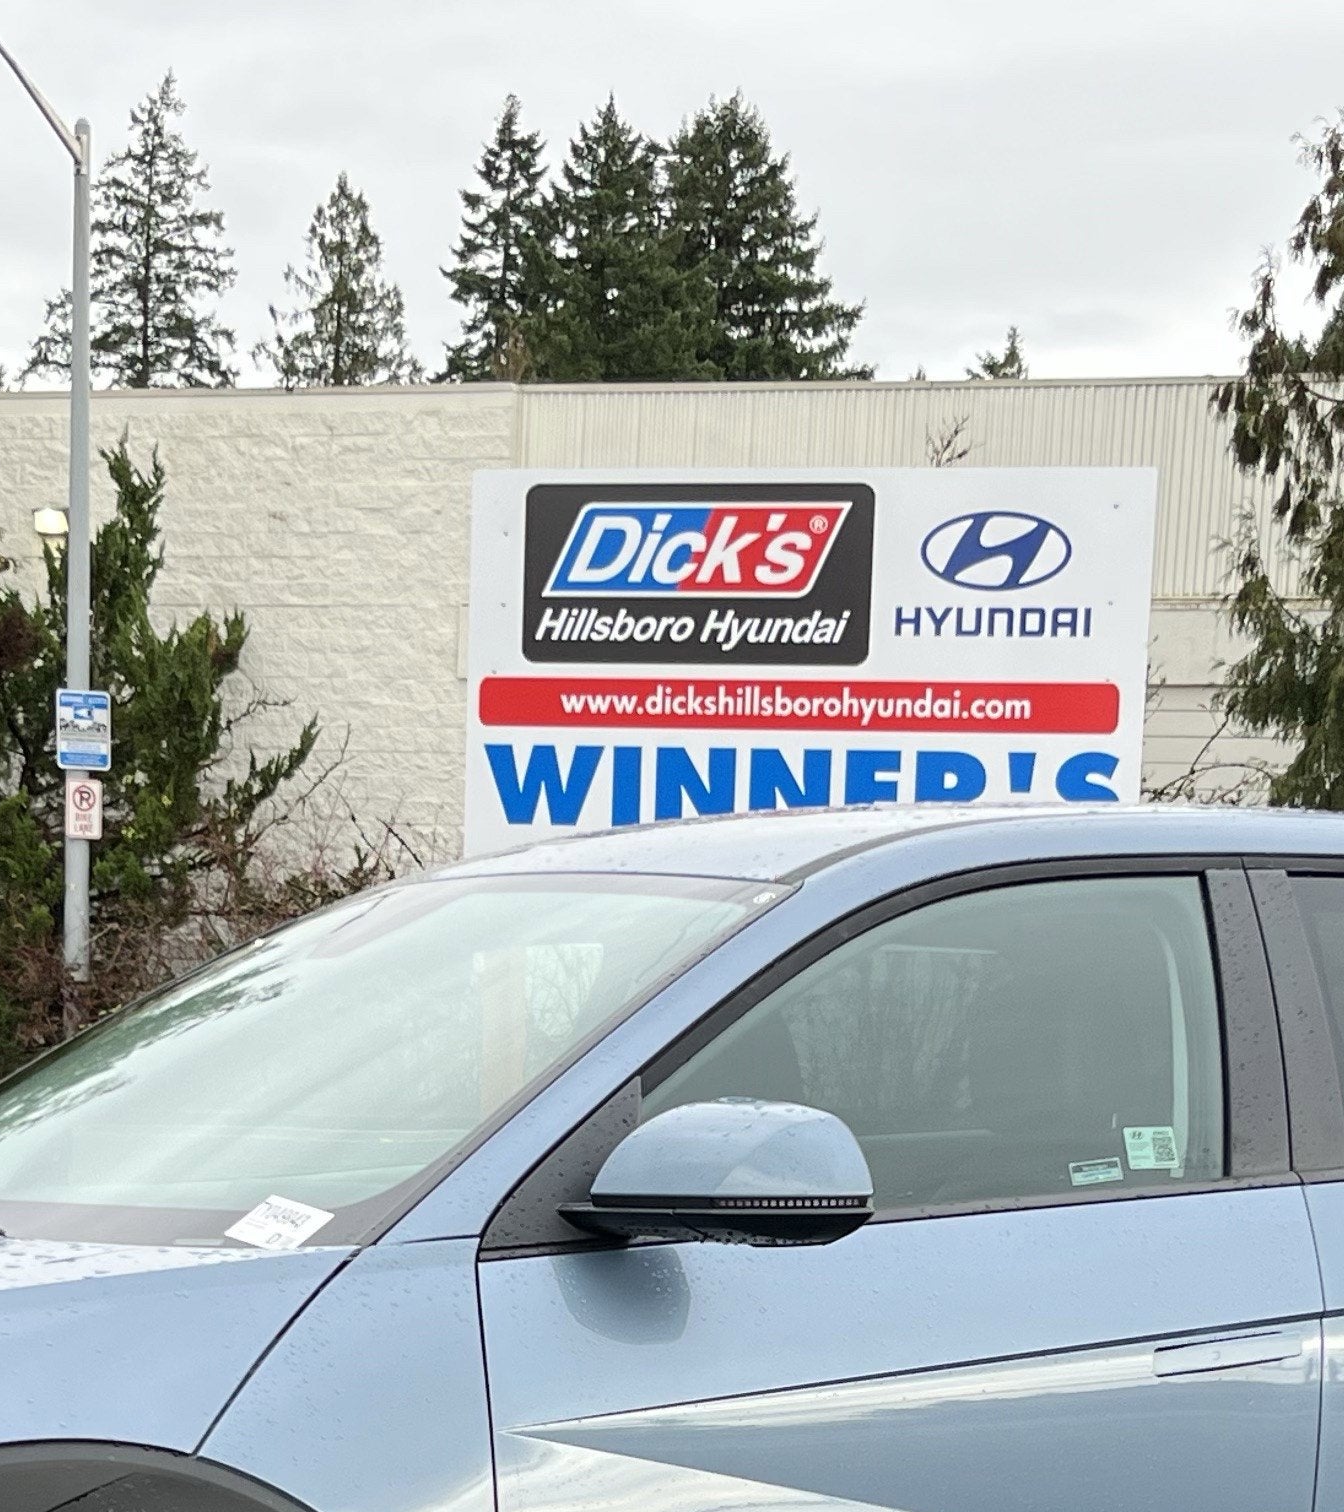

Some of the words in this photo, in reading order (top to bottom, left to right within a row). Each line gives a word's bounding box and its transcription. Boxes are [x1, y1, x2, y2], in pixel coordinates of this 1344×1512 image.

[535, 606, 694, 645] Hillsboro
[700, 609, 851, 653] Hyundai
[894, 605, 1093, 638] HYUNDAI
[560, 685, 1032, 728] www.dickshillsborohyundai.com
